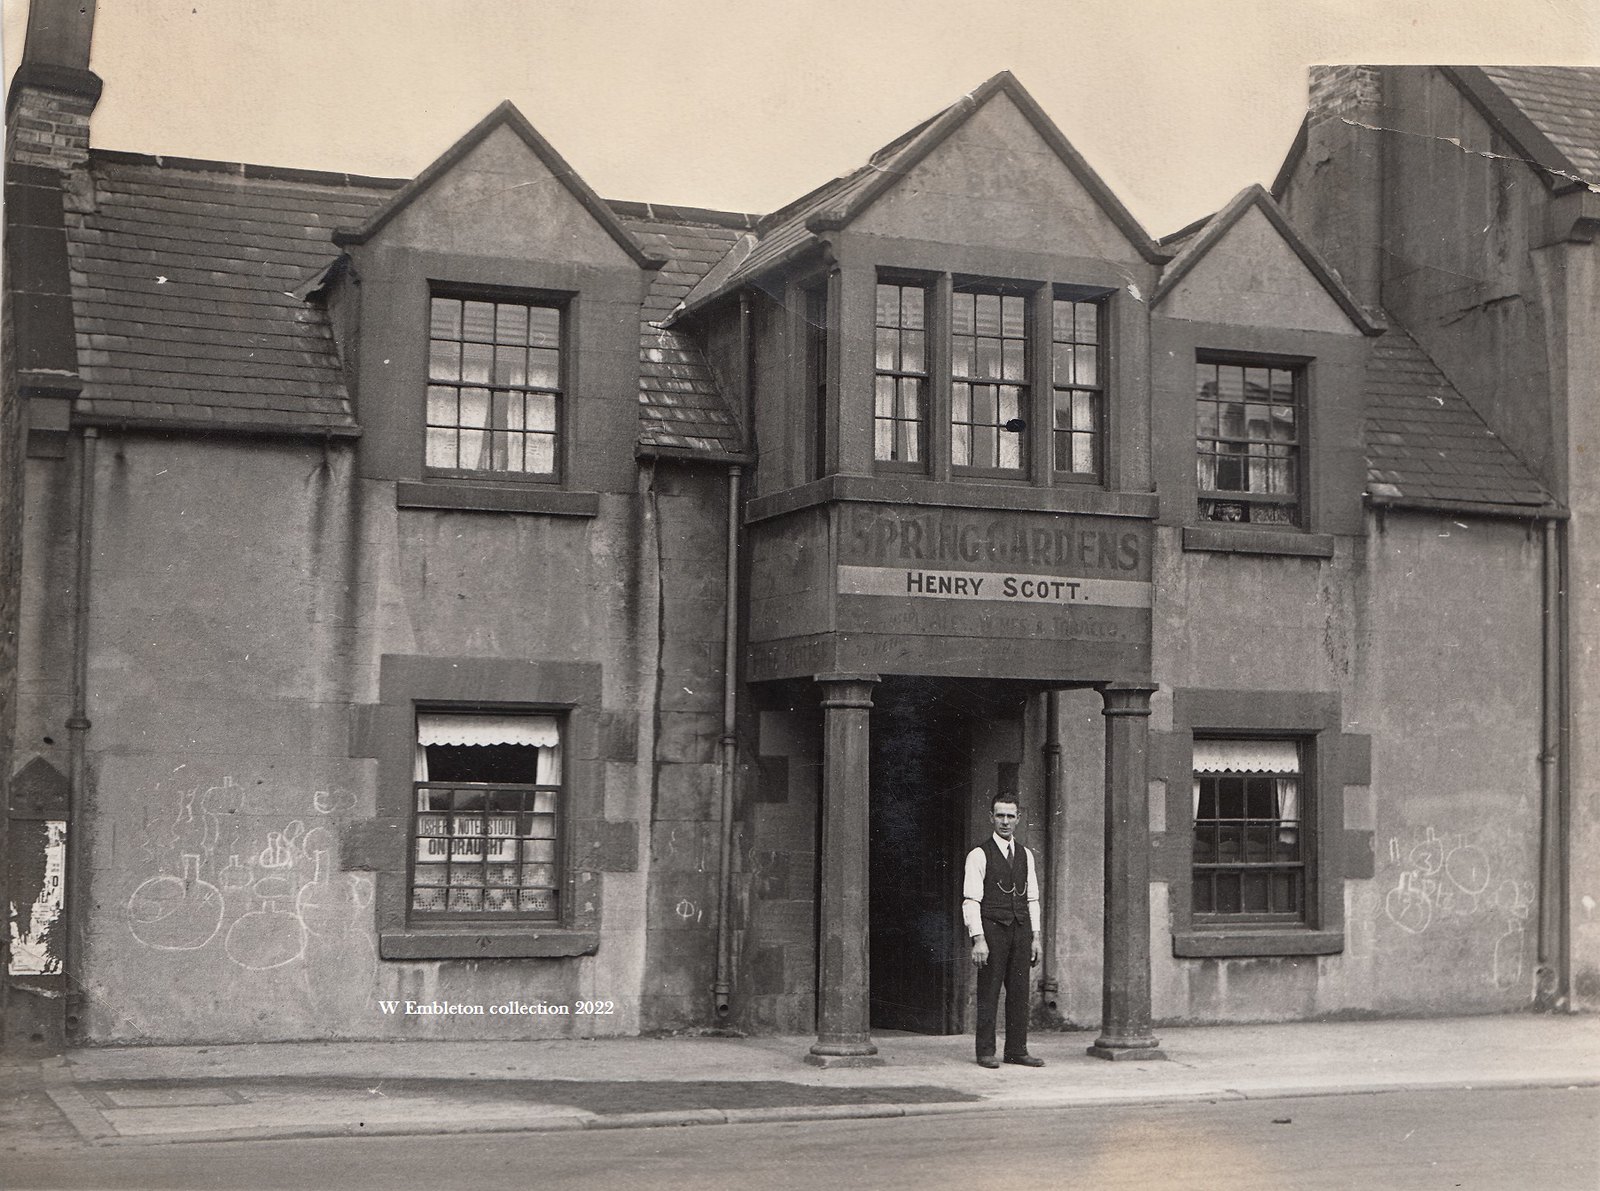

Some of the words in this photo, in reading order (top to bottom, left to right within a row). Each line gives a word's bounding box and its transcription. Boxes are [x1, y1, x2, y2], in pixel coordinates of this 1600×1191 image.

[985, 518, 1140, 571] GARDENS
[906, 572, 984, 596] HENRY
[1003, 577, 1089, 601] SCOTT.
[428, 838, 446, 855] ON
[449, 838, 506, 856] DRAUHT
